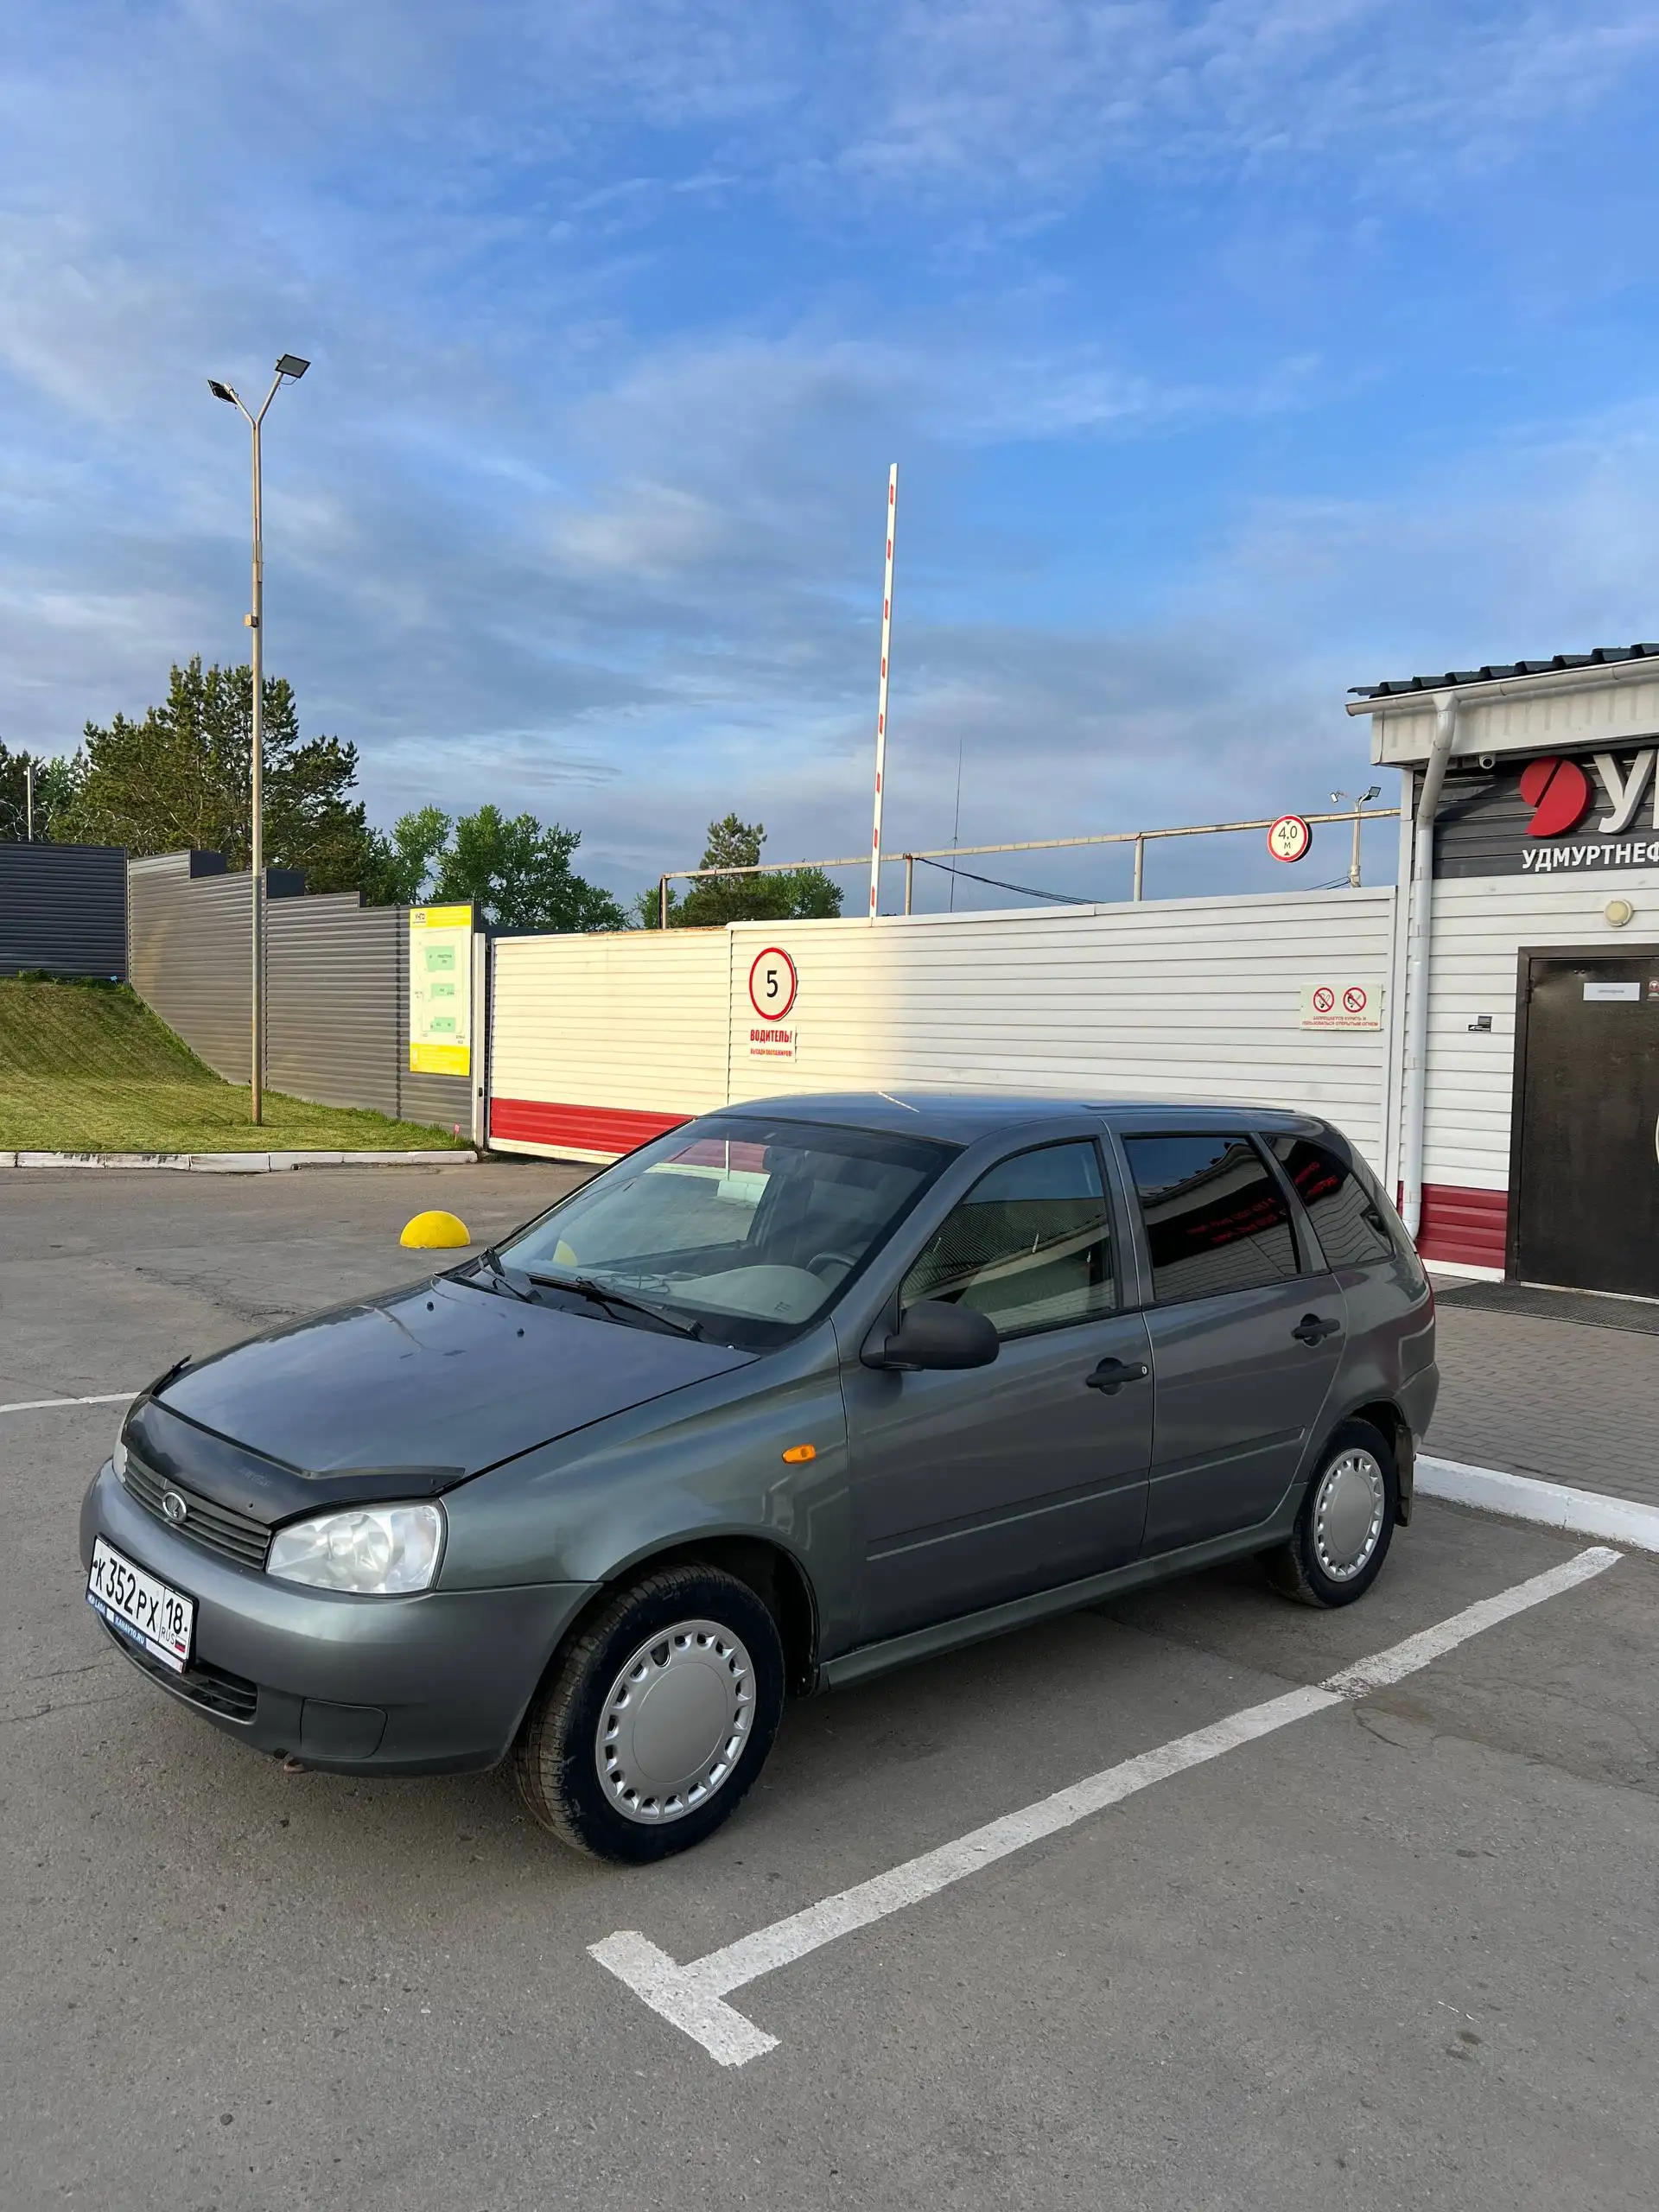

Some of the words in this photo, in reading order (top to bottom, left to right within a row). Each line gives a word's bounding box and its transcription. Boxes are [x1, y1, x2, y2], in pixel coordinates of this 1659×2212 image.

[1593, 749, 1659, 834] У
[766, 969, 779, 998] 5
[750, 1029, 793, 1043] ВОДИТЕЛЬ!
[166, 1597, 183, 1635] 18
[161, 1626, 175, 1645] RUS
